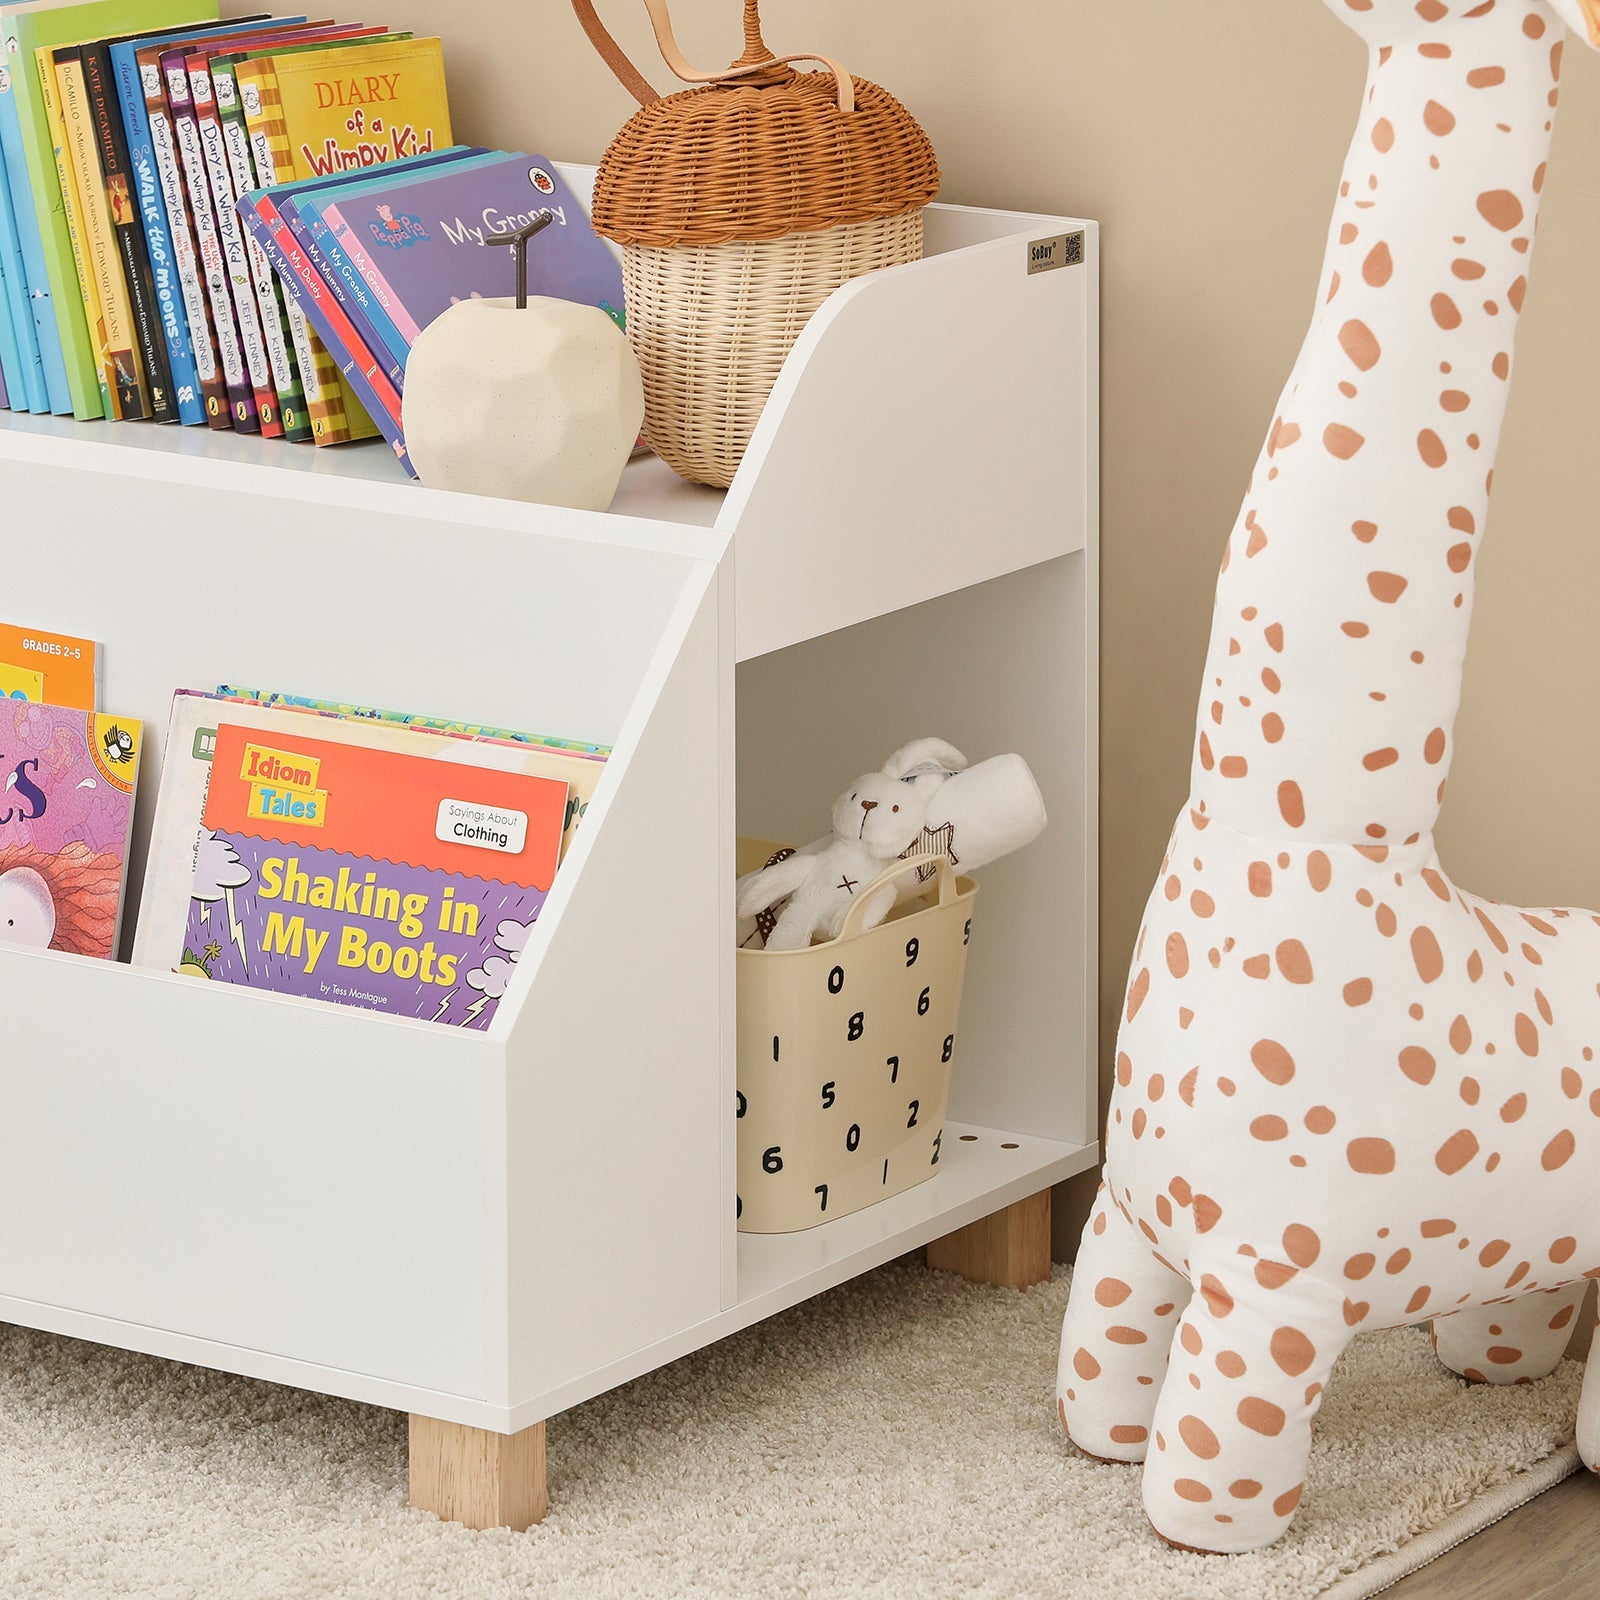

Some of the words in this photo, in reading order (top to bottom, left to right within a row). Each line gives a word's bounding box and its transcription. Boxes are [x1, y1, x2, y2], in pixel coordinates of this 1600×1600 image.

[88, 56, 102, 93] KATE
[120, 61, 133, 98] Sharon
[128, 101, 143, 136] Creech
[313, 72, 401, 109] DIARY
[153, 115, 168, 151] Diary
[181, 120, 196, 154] Diary
[346, 108, 364, 135] of
[371, 118, 383, 133] a
[163, 152, 171, 162] of
[203, 124, 222, 166] Diary
[228, 125, 242, 158] Diary
[238, 161, 246, 171] of
[255, 134, 270, 169] Diary
[265, 171, 273, 181] of
[303, 139, 388, 177] Wimpy
[391, 126, 432, 160] Kid
[58, 163, 67, 182] NATE
[191, 156, 199, 166] of
[216, 169, 225, 181] of
[138, 158, 160, 224] WALK
[165, 170, 178, 207] Wimpy
[192, 174, 205, 212] Wimpy
[65, 201, 74, 223] GREAT
[172, 208, 183, 227] Kid
[200, 213, 211, 231] Kid
[218, 192, 234, 239] Wimpy
[70, 225, 78, 240] AND
[147, 225, 167, 265] two
[207, 232, 216, 248] THE
[368, 223, 412, 249] Peppa
[400, 216, 429, 237] Pig
[439, 216, 486, 247] My
[73, 242, 81, 255] THE
[201, 240, 212, 269] TRUTH
[211, 248, 222, 272] UGLY
[227, 241, 242, 264] Kid
[76, 257, 86, 283] STICKY
[88, 193, 100, 234] JOURNEY
[95, 241, 111, 293] EDWARD
[106, 292, 121, 342] TULANE
[264, 239, 277, 259] My
[275, 257, 302, 299] Mummy
[289, 250, 302, 269] My
[301, 266, 322, 299] Daddy
[308, 243, 320, 263] My
[319, 261, 346, 303] Mummy
[329, 247, 342, 267] My
[341, 265, 369, 308] Grandpa
[353, 252, 366, 272] My
[366, 270, 391, 308] Granny
[156, 267, 180, 338] moons
[216, 297, 229, 325] JEFF
[188, 292, 200, 320] JEFF
[195, 326, 210, 373] KINNEY
[240, 299, 253, 328] JEFF
[247, 332, 263, 380] KINNEY
[264, 303, 277, 332] JEFF
[271, 336, 288, 385] KINNEY
[222, 331, 238, 378] KINNEY
[292, 312, 305, 341] JEFF
[300, 346, 315, 394] KINNEY
[22, 637, 62, 656] GRADES
[247, 750, 312, 787] Idiom
[259, 788, 317, 819] Tales
[448, 804, 485, 823] Sayings
[486, 812, 518, 827] About
[453, 822, 508, 848] Clothing
[257, 856, 429, 939] Shaking
[438, 887, 480, 937] in
[261, 911, 330, 975] My
[337, 925, 458, 987] Boots
[905, 937, 920, 968] 9
[319, 980, 331, 994] by
[332, 983, 348, 997] Tess
[349, 988, 389, 1004] Montague
[917, 985, 931, 1016] 6
[847, 1011, 865, 1042] 8
[940, 1033, 954, 1063] 8
[886, 1055, 900, 1084] 7
[821, 1080, 836, 1110] 5
[906, 1099, 920, 1129] 2
[762, 1145, 784, 1175] 6
[814, 1183, 829, 1212] 7
